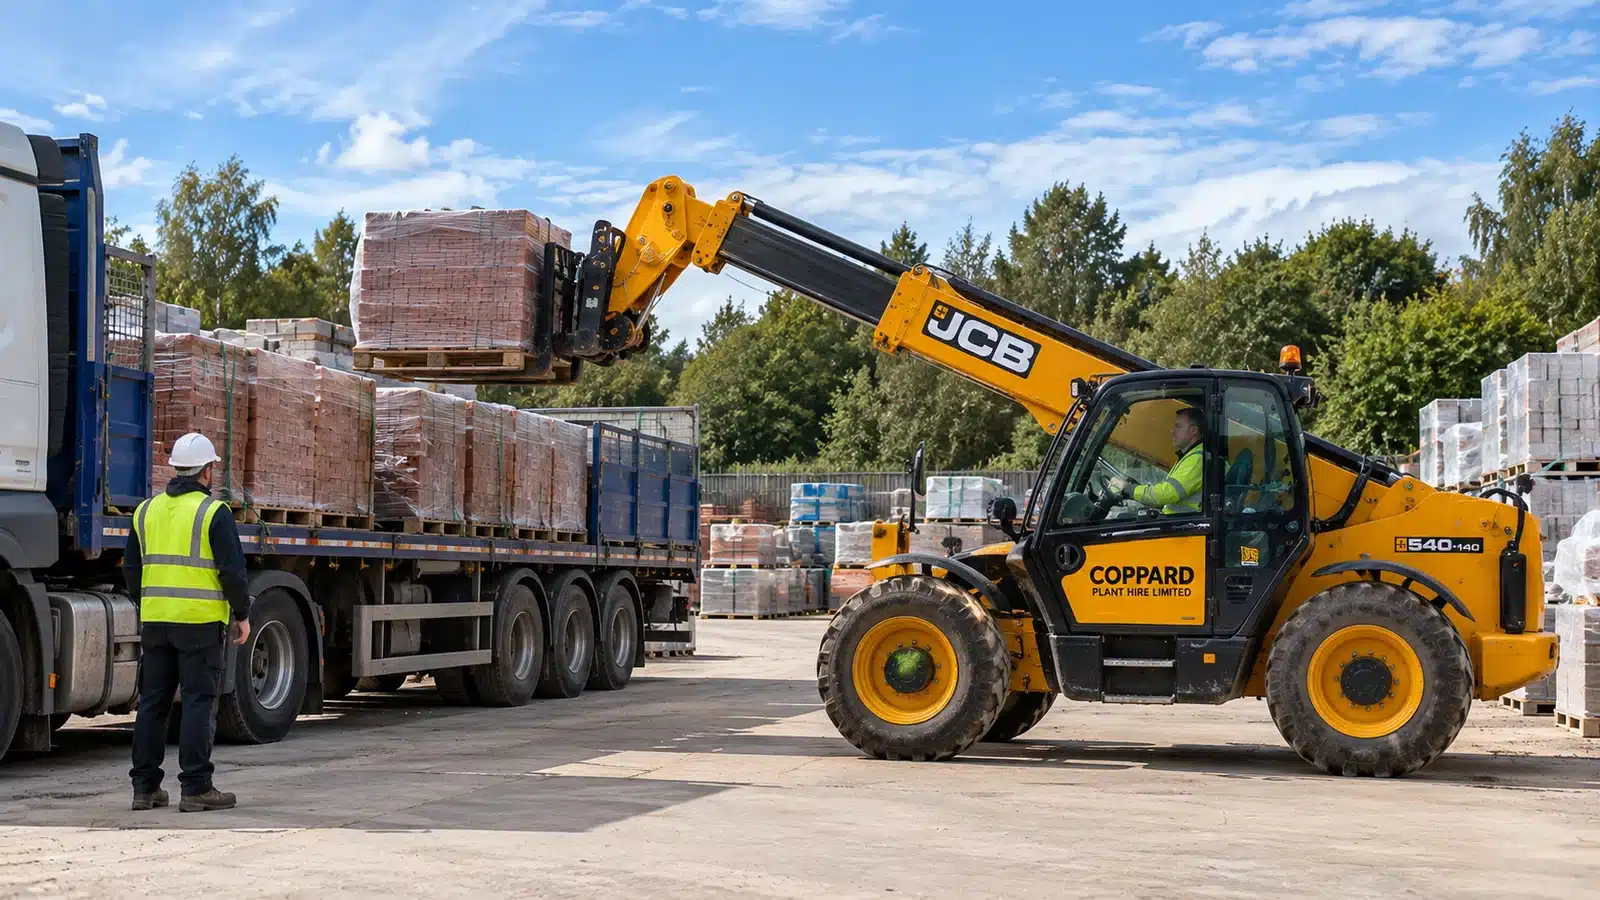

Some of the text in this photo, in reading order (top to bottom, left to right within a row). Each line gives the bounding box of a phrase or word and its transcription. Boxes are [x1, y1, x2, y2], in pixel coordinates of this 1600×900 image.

[927, 311, 1035, 373] JCB
[1089, 565, 1195, 585] COPPARD
[1092, 587, 1192, 597] PLANT HIRE LIMITED
